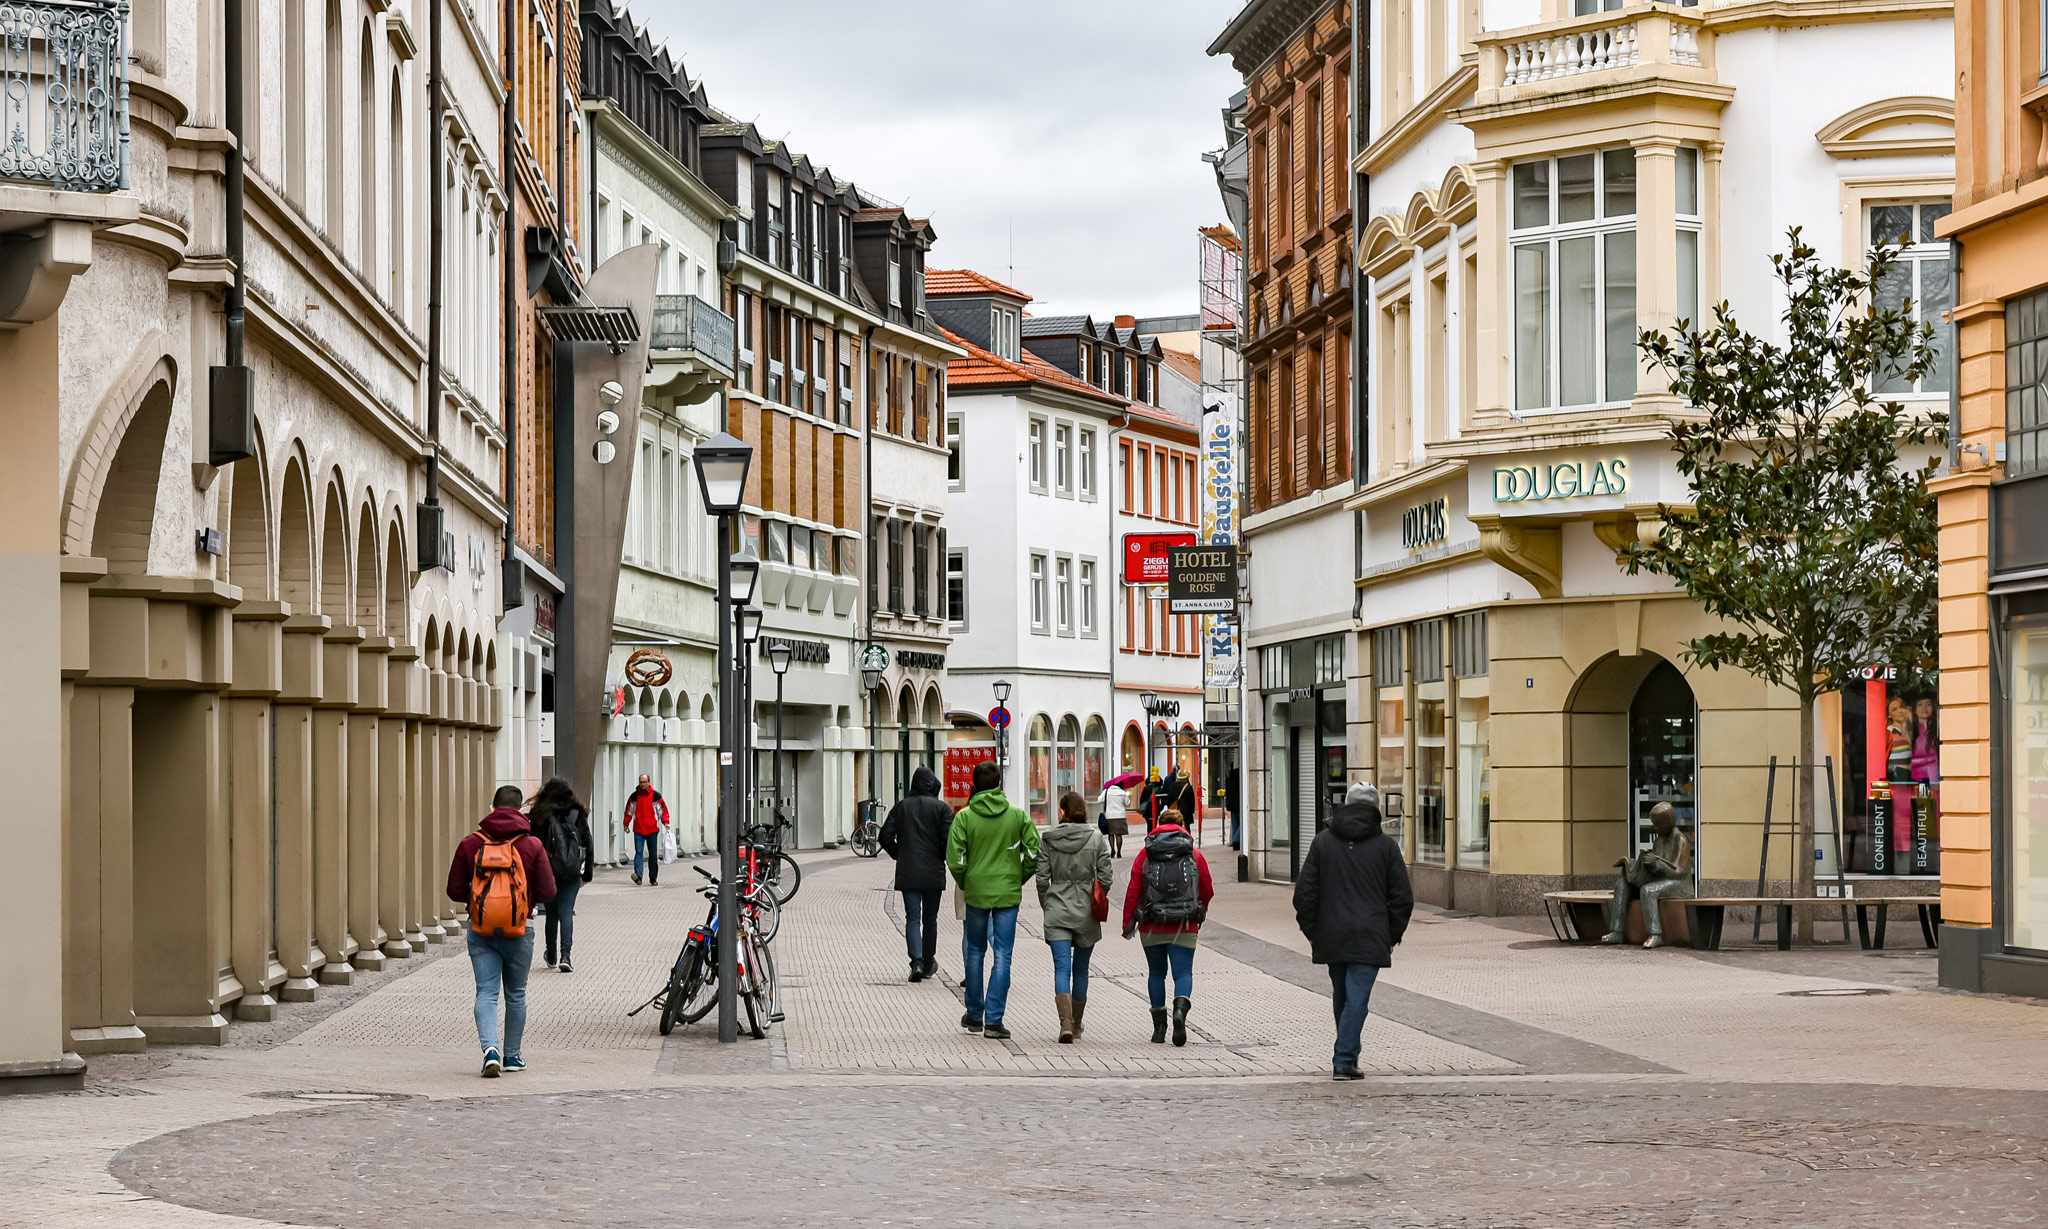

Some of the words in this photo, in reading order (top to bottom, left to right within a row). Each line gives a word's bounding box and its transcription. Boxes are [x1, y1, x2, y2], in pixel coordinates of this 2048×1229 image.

[1209, 424, 1232, 546] Baustelle
[1493, 459, 1626, 502] DOUGLAS
[1402, 498, 1445, 550] DOUGLAS
[1174, 551, 1231, 568] HOTEL
[1178, 572, 1227, 583] GOLDENE
[1189, 583, 1216, 593] ROSE
[760, 635, 804, 661] KAADT
[1874, 804, 1885, 870] CONFIDENT
[1917, 807, 1927, 867] BEAUTIFUL
